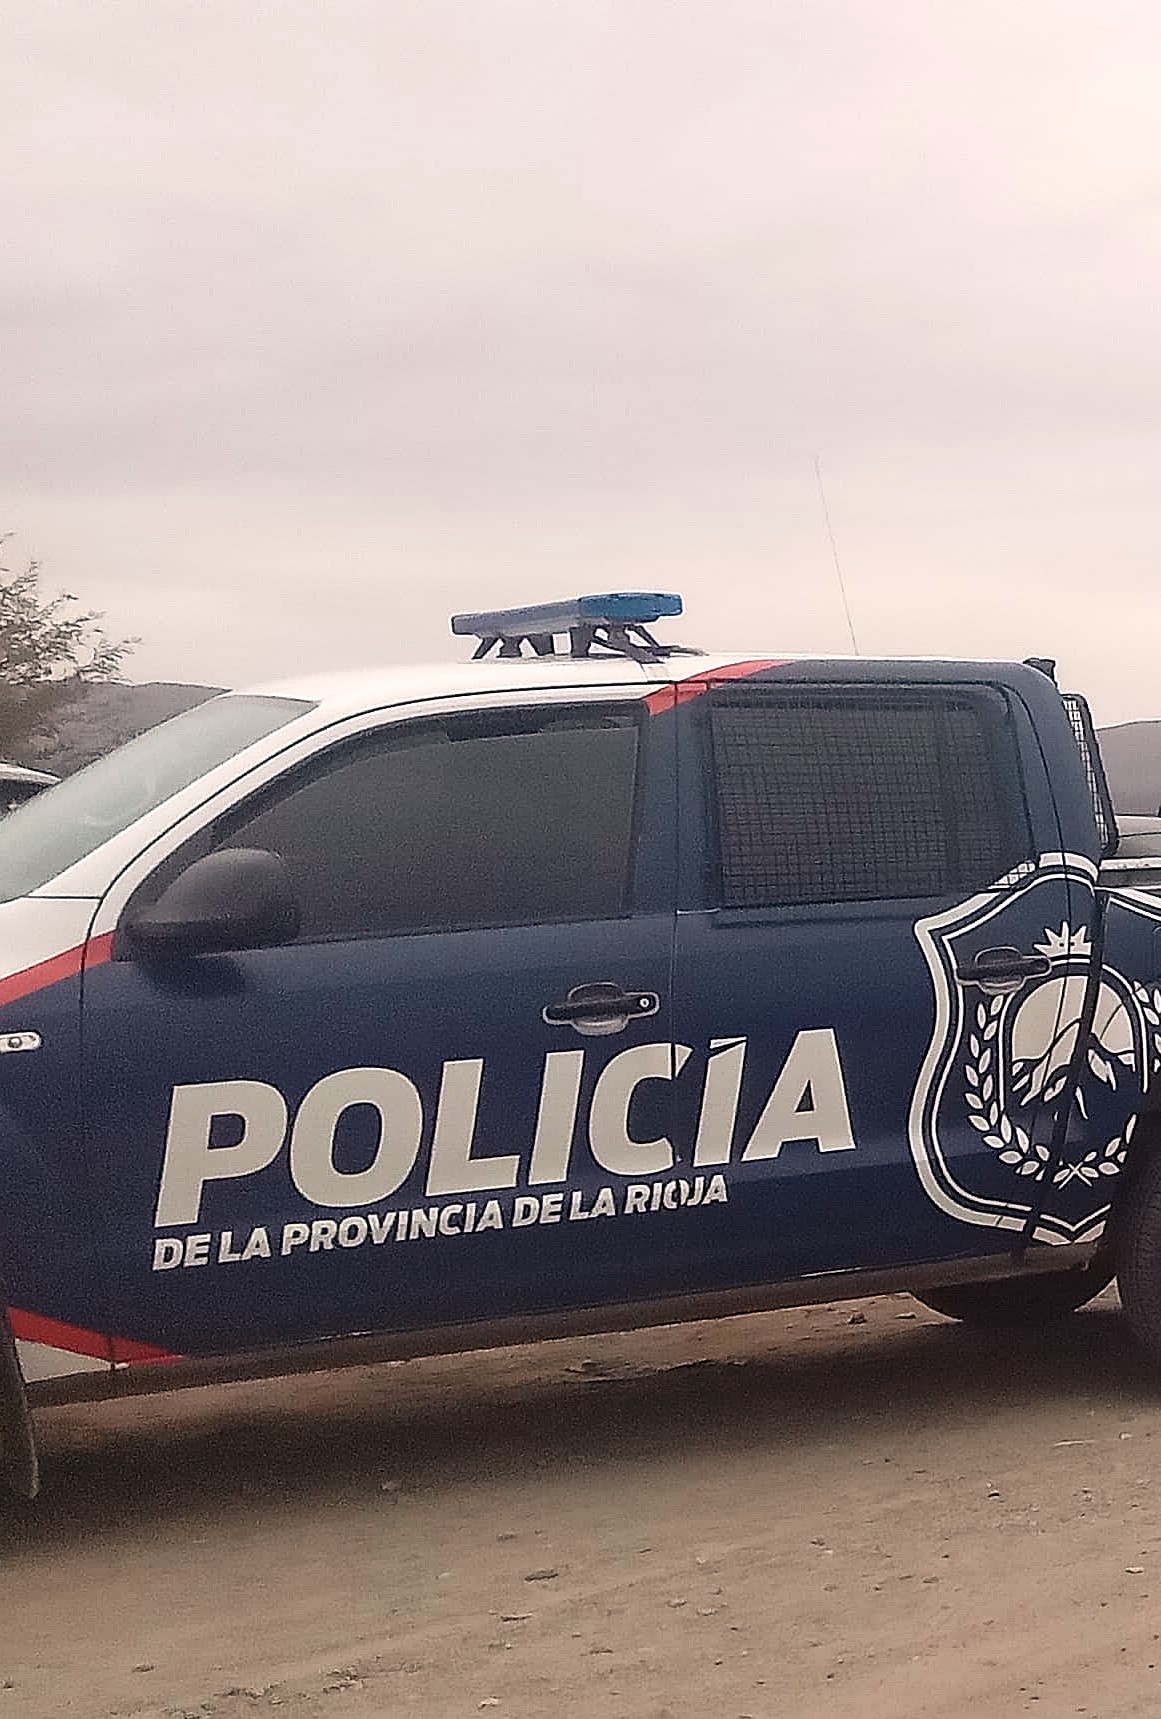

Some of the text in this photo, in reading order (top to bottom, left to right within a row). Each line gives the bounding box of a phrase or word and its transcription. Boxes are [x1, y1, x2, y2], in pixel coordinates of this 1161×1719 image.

[152, 1173, 728, 1272] DE LA PROVINCIA DE LA RIOJA
